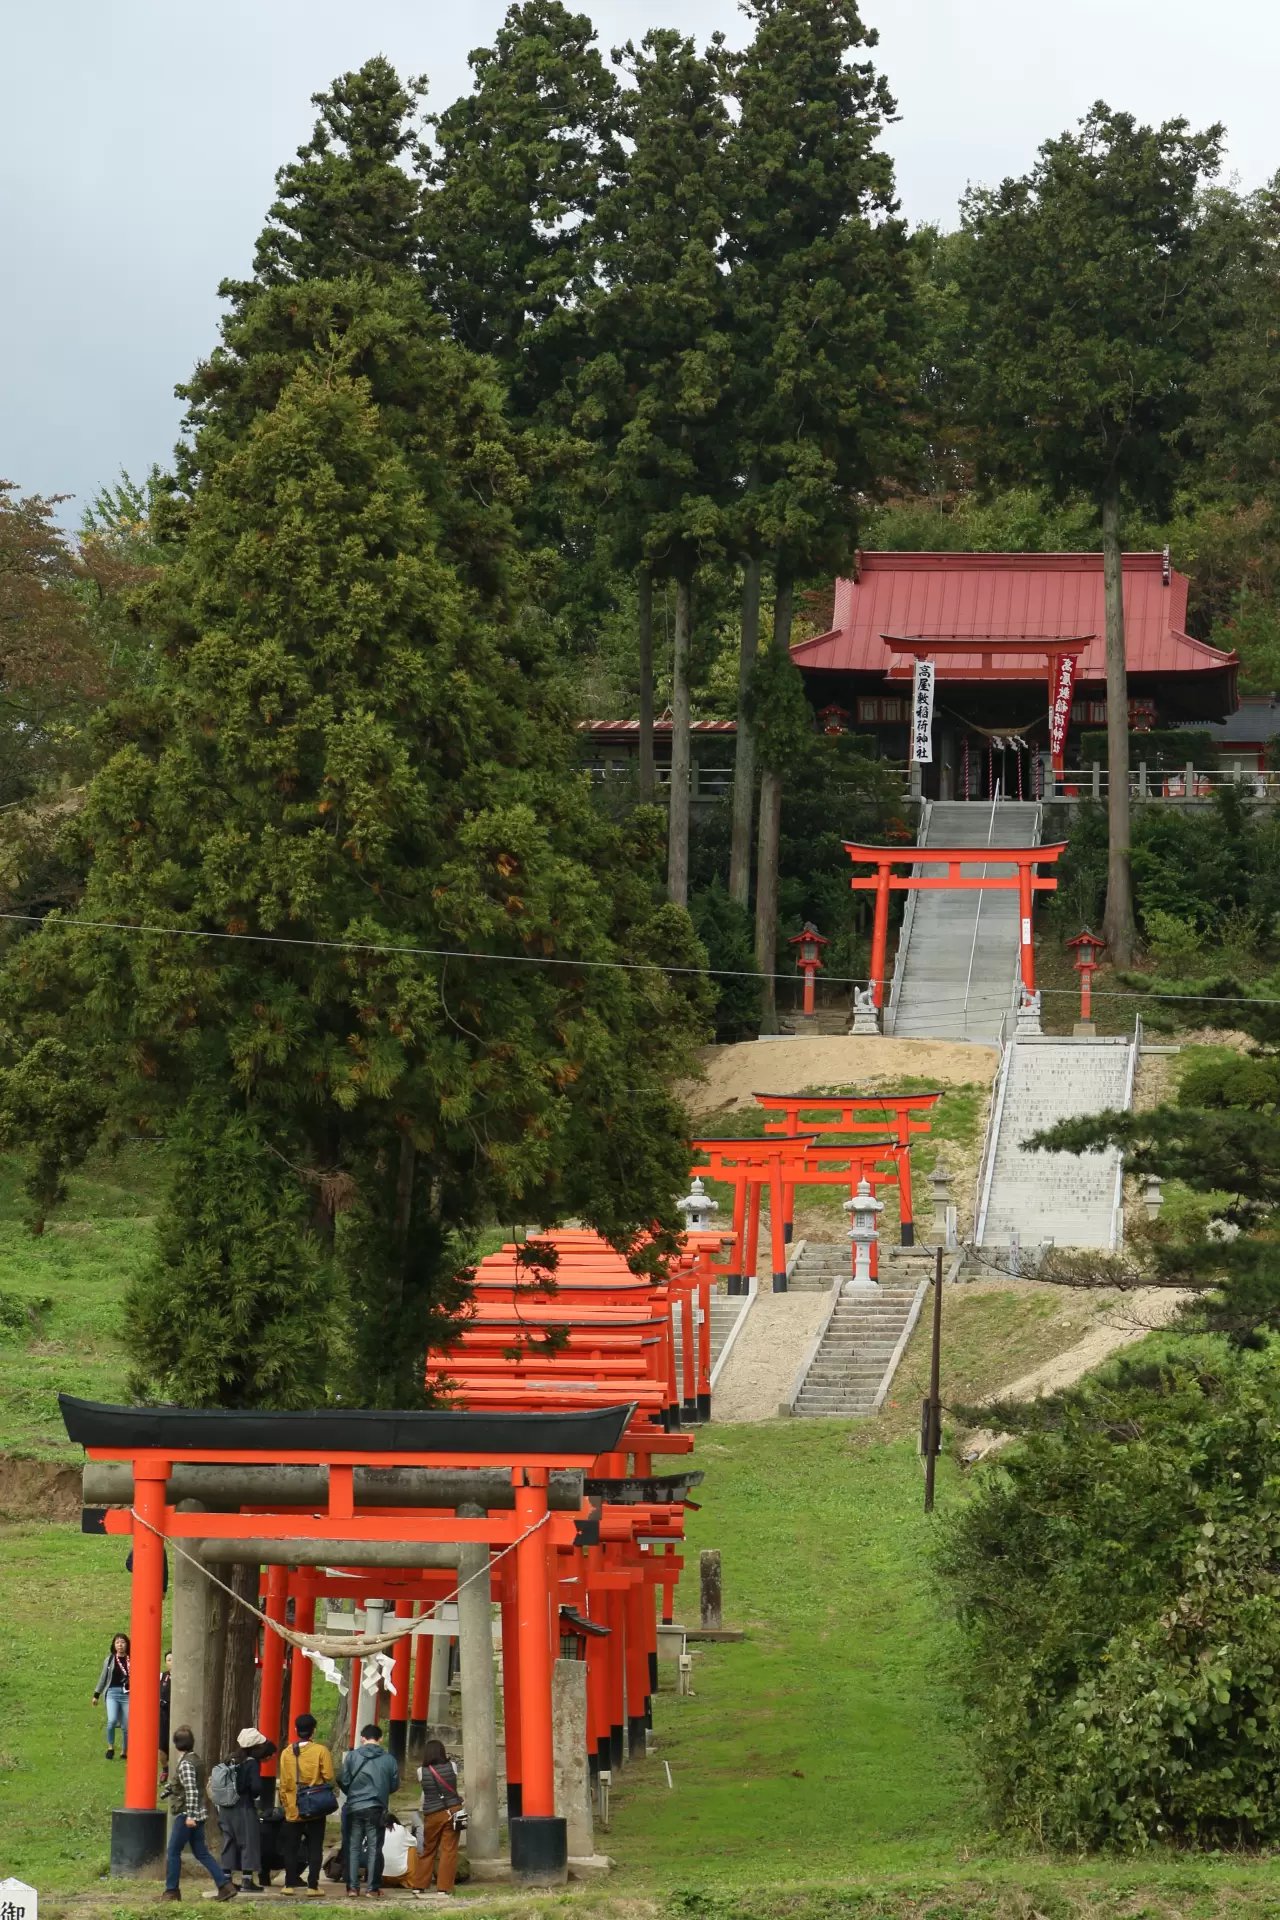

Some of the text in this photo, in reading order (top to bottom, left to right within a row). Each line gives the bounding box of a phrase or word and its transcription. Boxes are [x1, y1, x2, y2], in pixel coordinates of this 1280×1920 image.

[916, 664, 931, 759] 高屋敷稲荷神社
